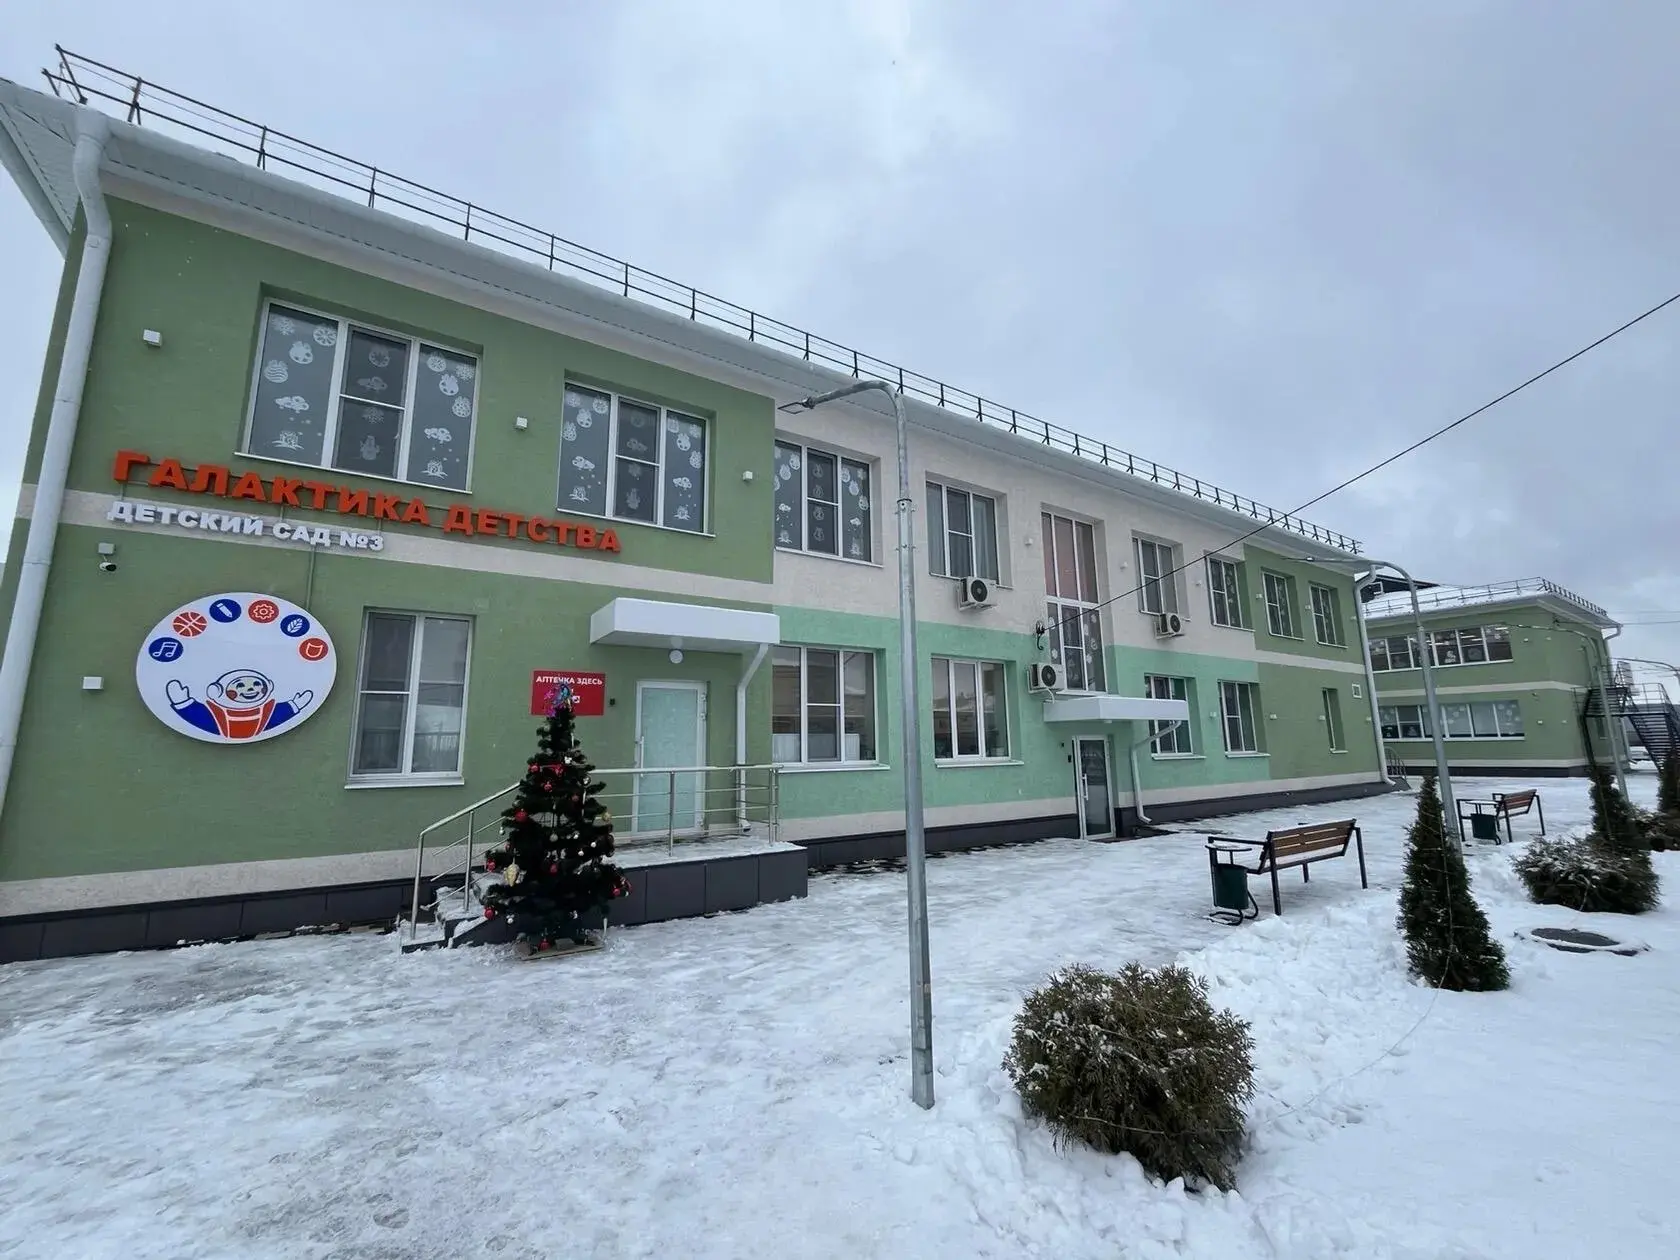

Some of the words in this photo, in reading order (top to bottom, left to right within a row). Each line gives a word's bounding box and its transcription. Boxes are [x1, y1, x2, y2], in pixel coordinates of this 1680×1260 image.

[107, 501, 263, 536] ДЕТСКИЙ
[273, 522, 331, 547] САД
[339, 532, 385, 551] №3
[112, 449, 430, 525] ГАЛАКТИКА
[443, 504, 622, 553] ДЕТСТВА
[536, 676, 575, 684] АПТЕЧКА
